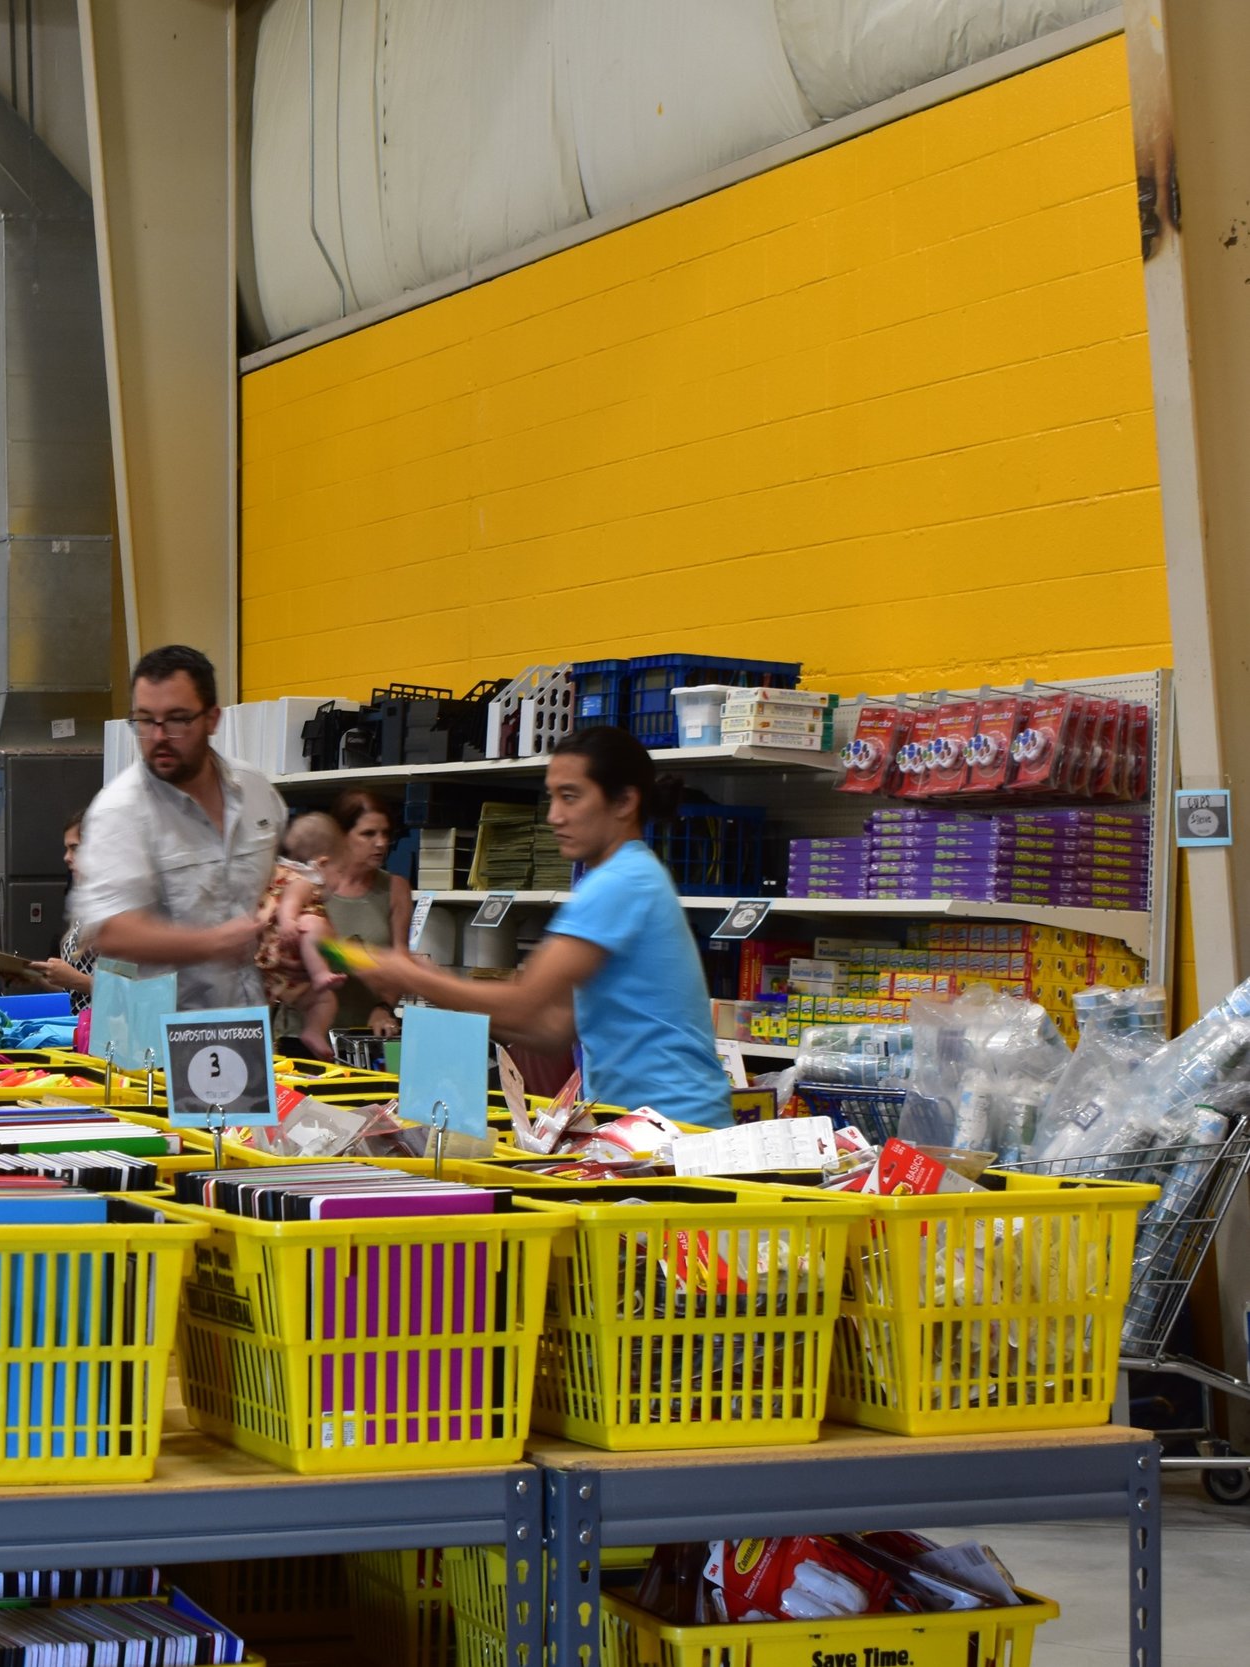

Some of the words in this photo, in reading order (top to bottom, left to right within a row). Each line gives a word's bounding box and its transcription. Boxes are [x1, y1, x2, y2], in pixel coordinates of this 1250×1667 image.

[169, 1030, 217, 1042] COMPOSITION
[217, 1027, 263, 1040] NOTEBOOKS
[210, 1052, 221, 1077] 3
[906, 1153, 925, 1181] BASICS
[737, 1538, 761, 1572] Comman
[812, 1650, 857, 1667] Save
[863, 1647, 914, 1667] Time.
